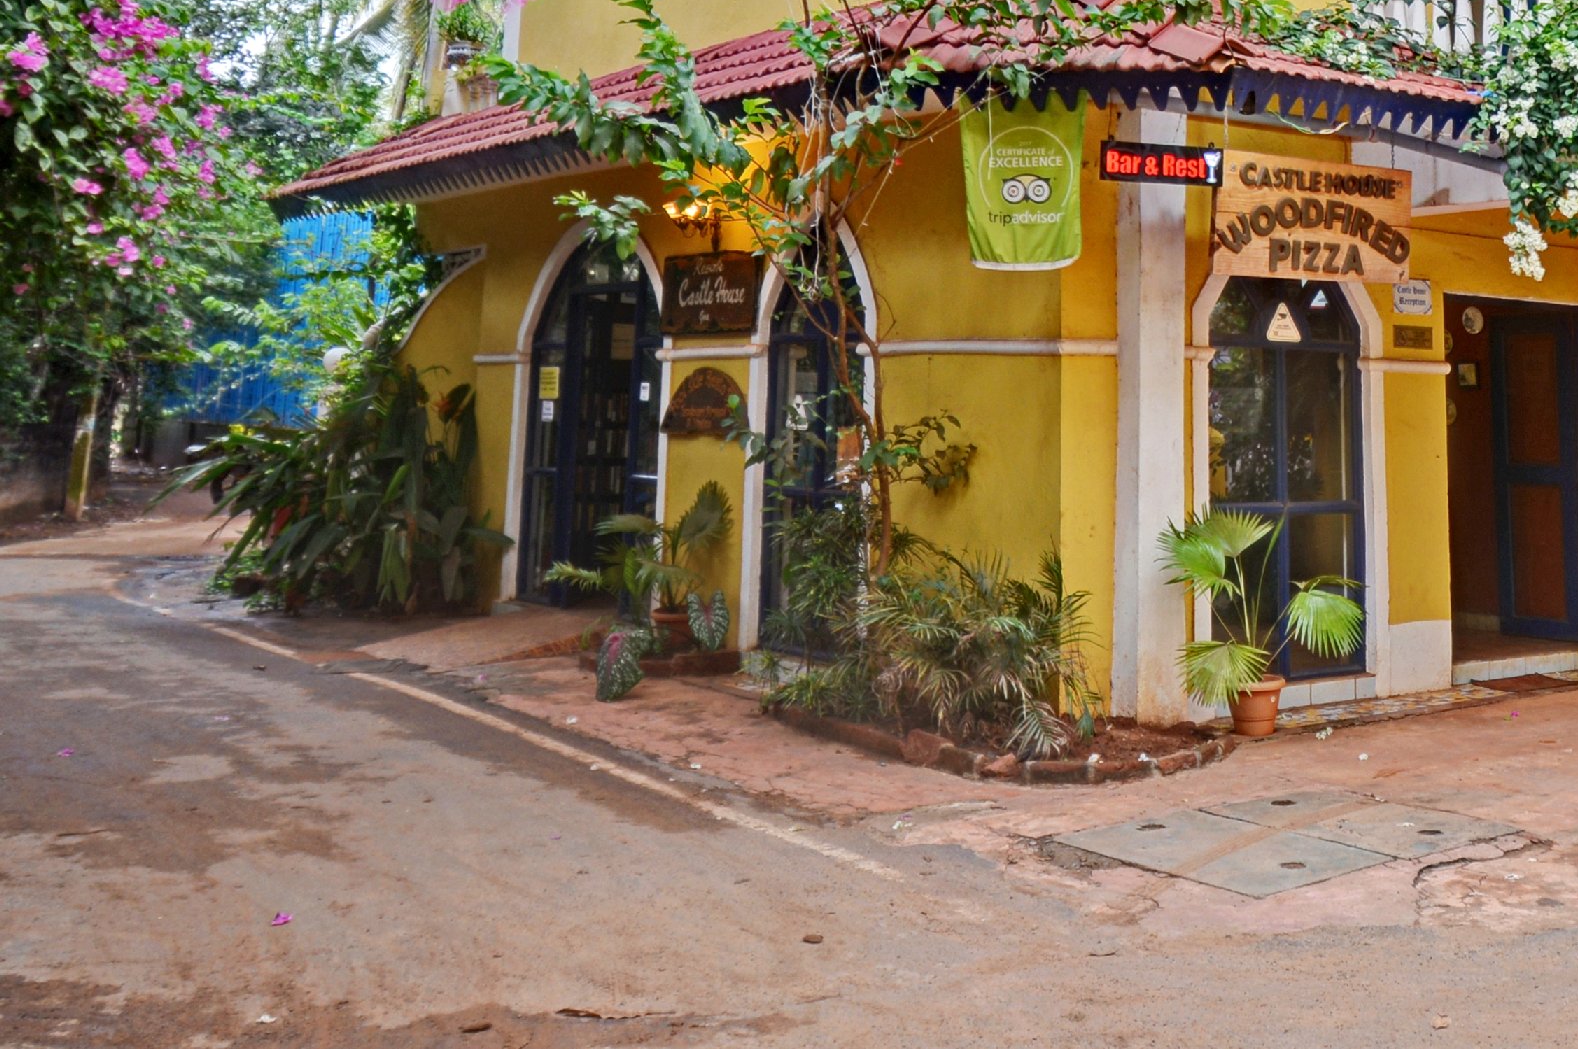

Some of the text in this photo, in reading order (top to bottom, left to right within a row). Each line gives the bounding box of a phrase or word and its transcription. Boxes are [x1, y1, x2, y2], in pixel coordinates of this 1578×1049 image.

[989, 156, 1064, 168] EXCELLENCE
[996, 147, 1046, 156] CERTIFICATE
[1106, 150, 1141, 174] Bar
[1144, 155, 1159, 176] &
[1239, 162, 1397, 200] CASTLE HOUSE
[988, 211, 1064, 227] tripadvisor
[1216, 197, 1411, 265] WOODFIRED
[1268, 238, 1365, 277] PIZZA
[679, 275, 745, 307] Castle House
